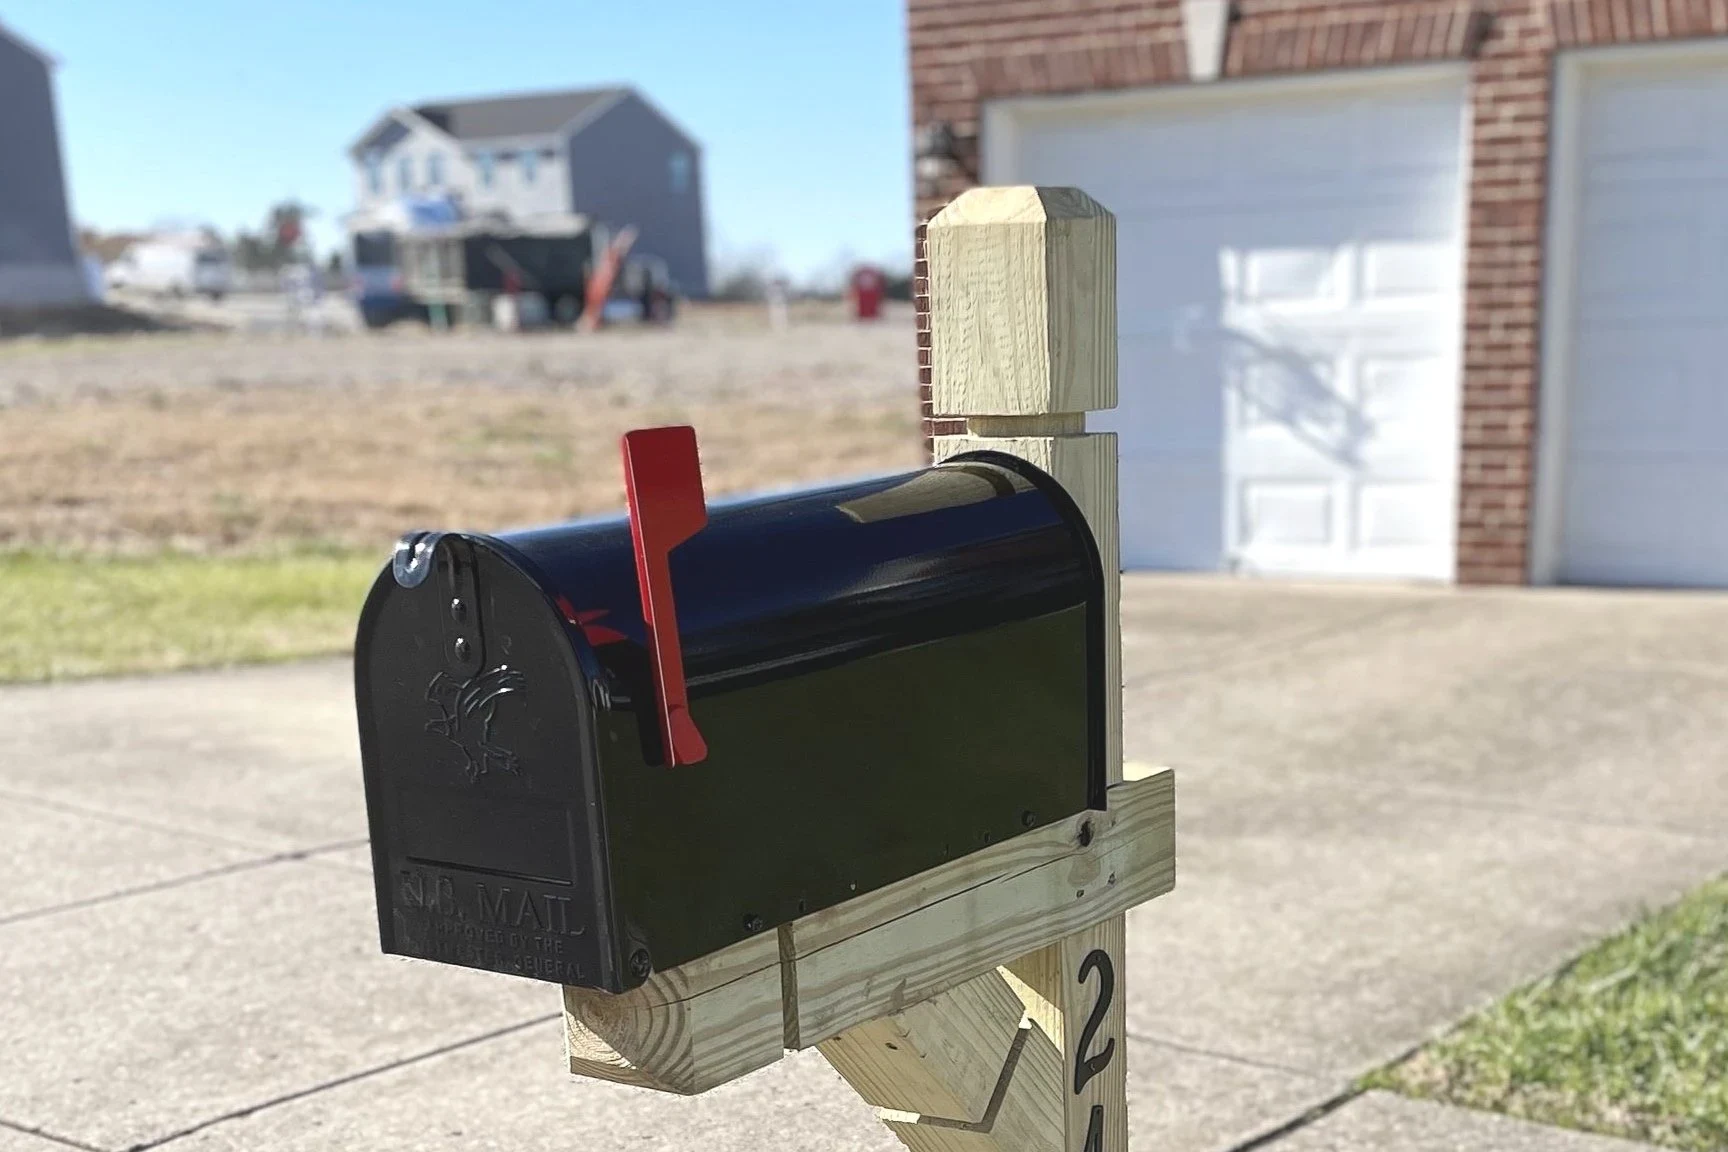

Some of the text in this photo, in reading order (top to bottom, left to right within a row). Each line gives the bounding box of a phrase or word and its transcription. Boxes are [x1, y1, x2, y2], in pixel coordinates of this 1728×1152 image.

[475, 882, 585, 935] MAIL
[509, 931, 528, 947] BY
[534, 935, 565, 954] THE
[513, 956, 585, 979] GENERAL
